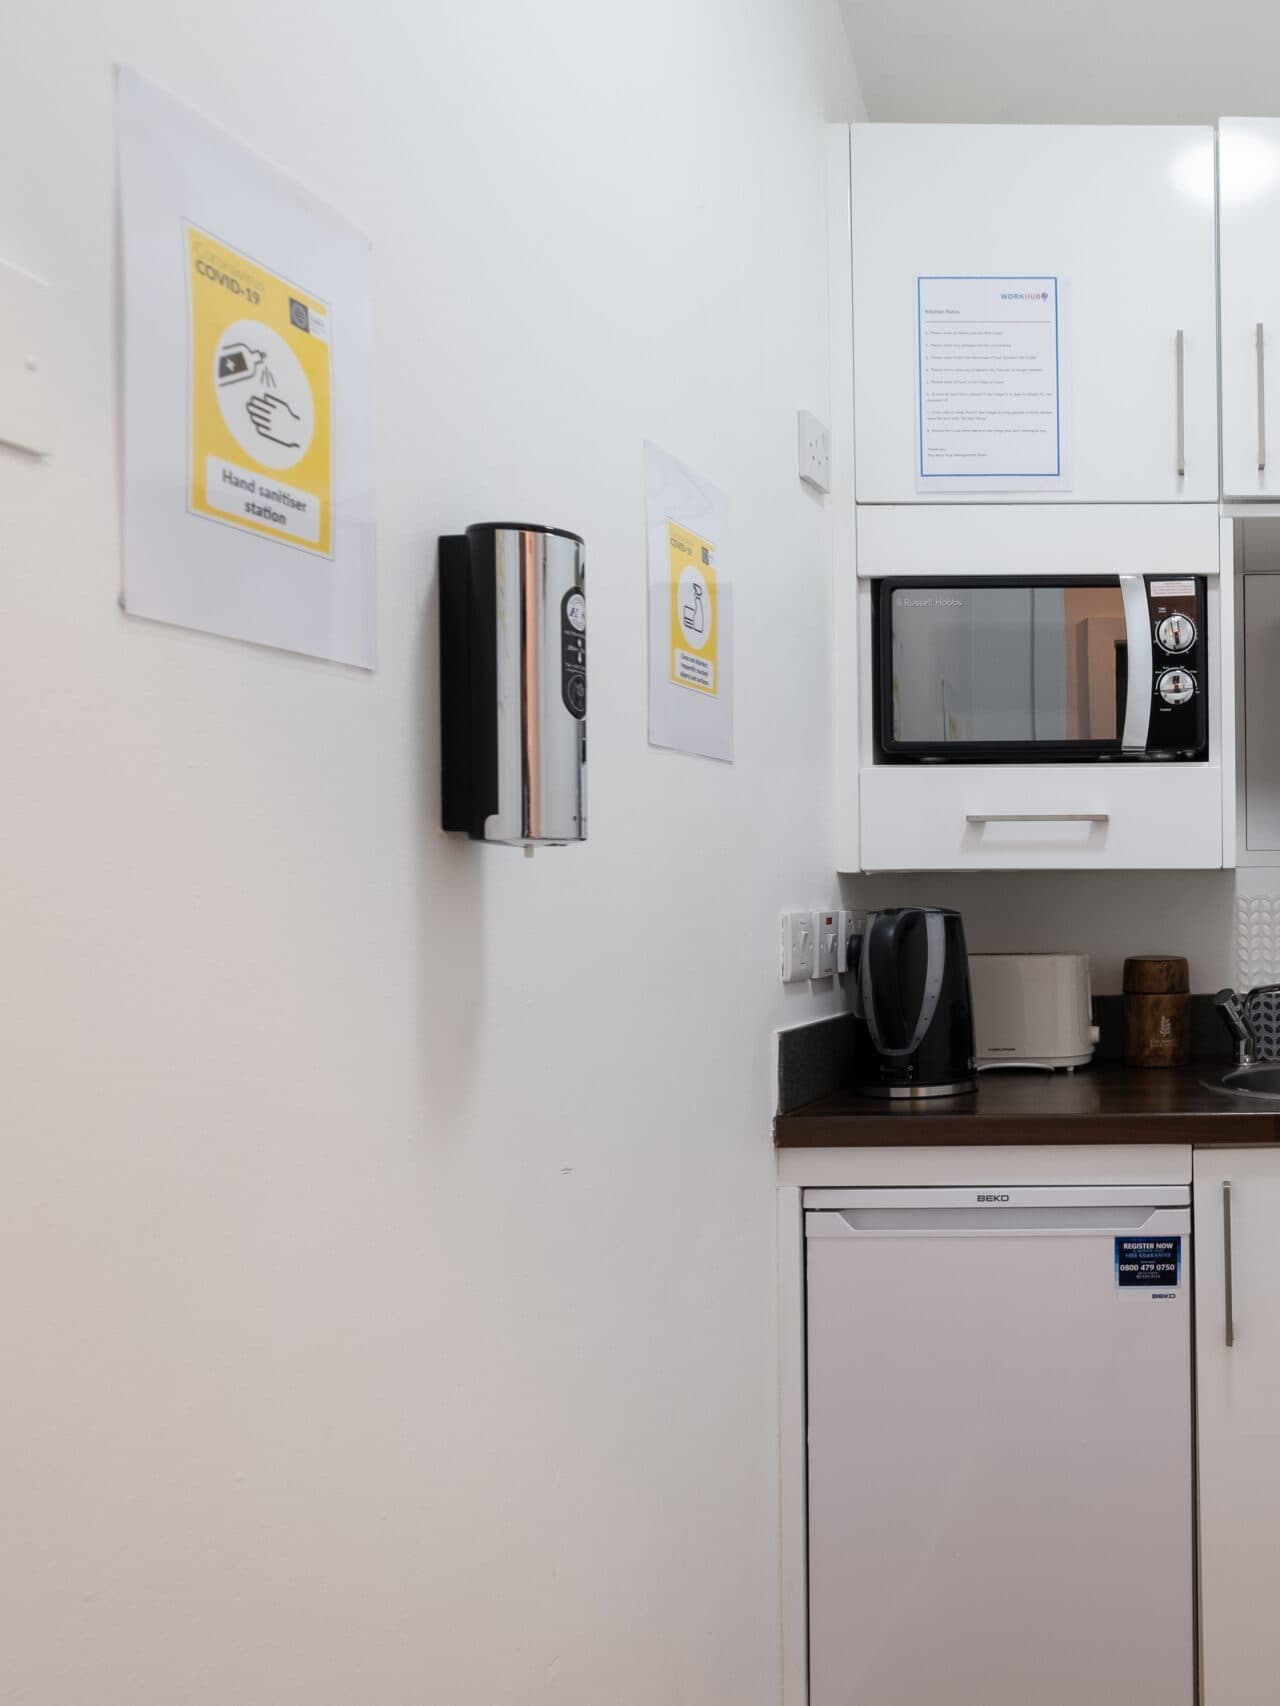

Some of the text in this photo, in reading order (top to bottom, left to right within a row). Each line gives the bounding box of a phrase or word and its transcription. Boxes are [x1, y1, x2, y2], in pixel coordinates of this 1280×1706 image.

[195, 259, 260, 304] COVID-19
[222, 469, 307, 512] Hand sanitiser
[245, 502, 287, 526] station
[977, 1194, 1009, 1202] BEKO
